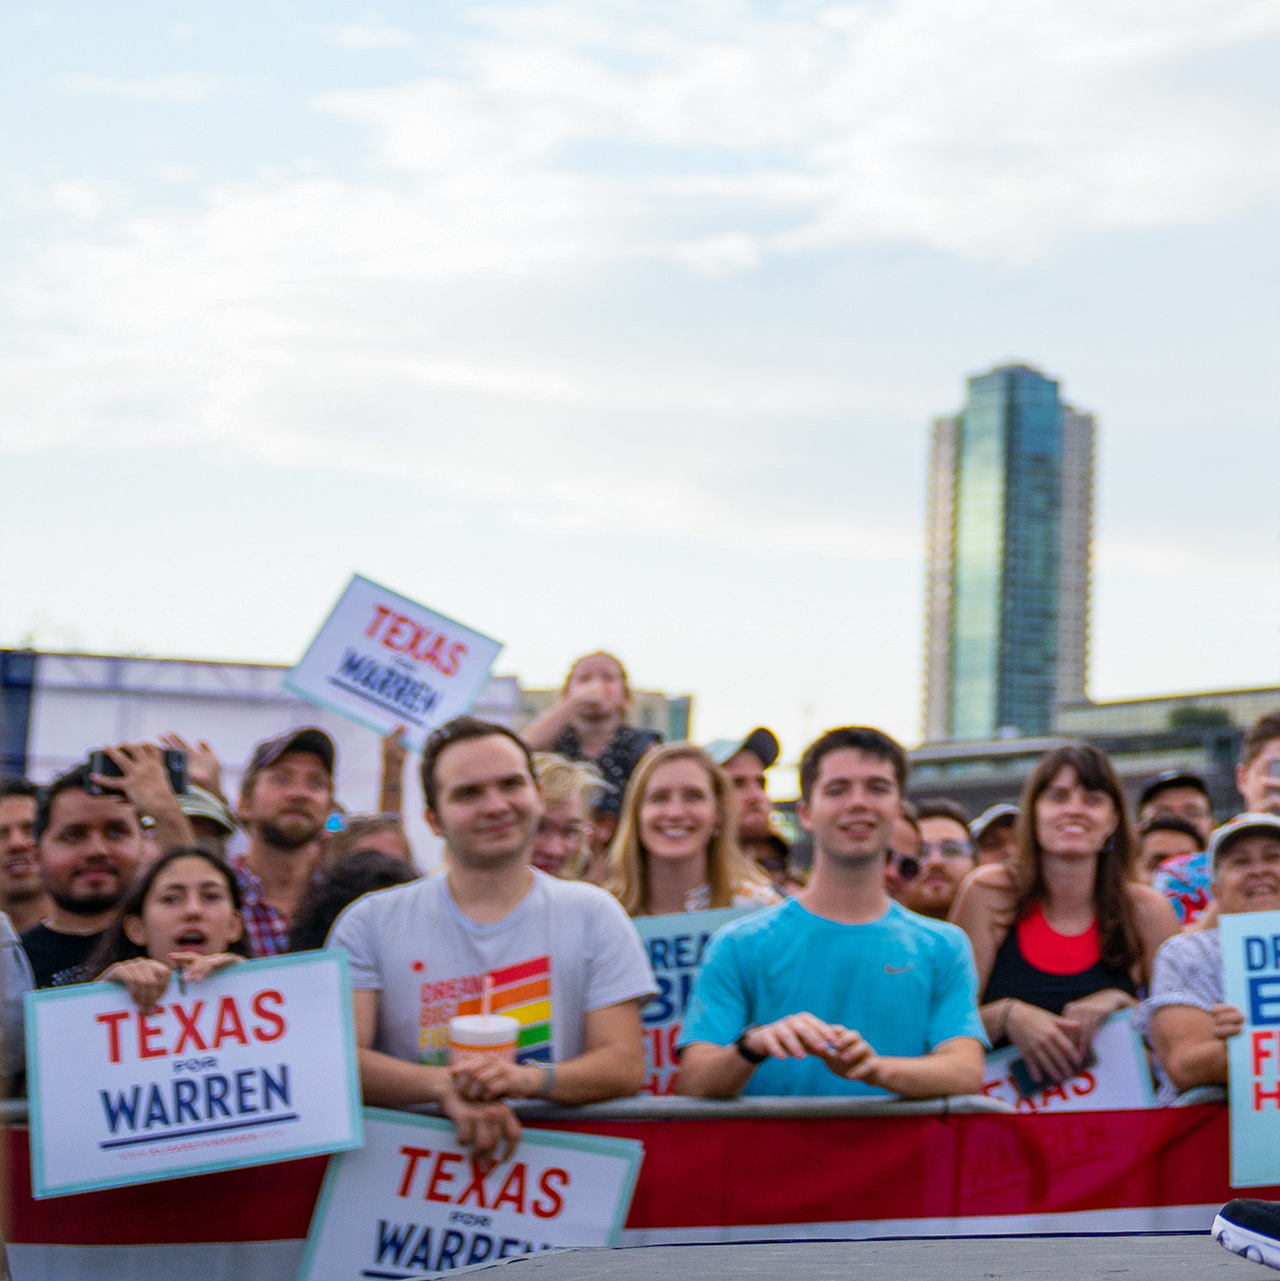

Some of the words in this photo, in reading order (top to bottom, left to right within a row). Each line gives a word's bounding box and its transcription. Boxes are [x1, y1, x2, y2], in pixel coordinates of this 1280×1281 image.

[365, 604, 467, 677] TEXAS
[338, 649, 441, 714] WARREN
[96, 988, 286, 1063] TEXAS
[100, 1064, 292, 1134] WARREN
[173, 1056, 218, 1073] FOR
[397, 1145, 570, 1219] TEXAS
[450, 1211, 492, 1227] FOR
